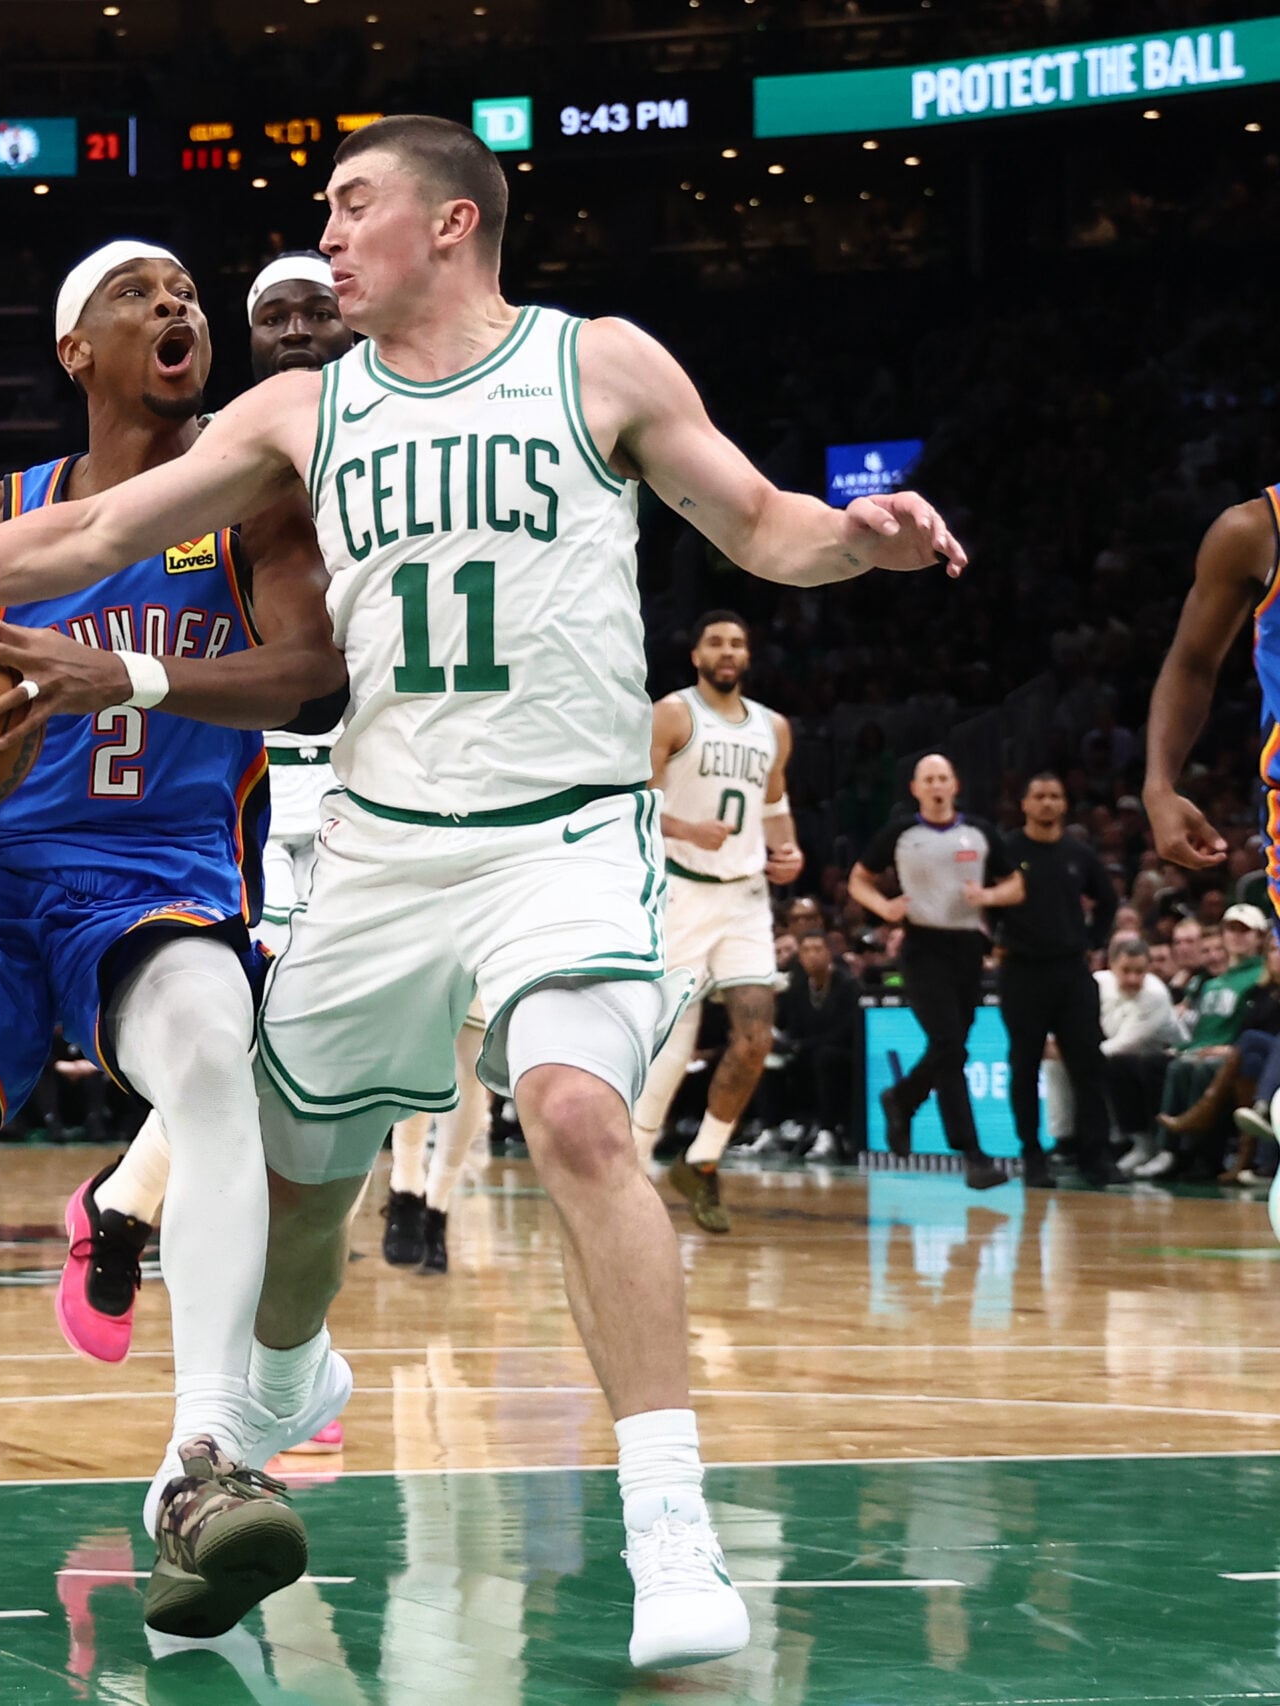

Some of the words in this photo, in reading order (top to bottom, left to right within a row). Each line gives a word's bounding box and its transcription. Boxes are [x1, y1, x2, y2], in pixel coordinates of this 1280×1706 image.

[912, 51, 1079, 119] PROTECT
[1083, 43, 1138, 97] THE
[1143, 30, 1245, 91] BALL
[477, 106, 527, 142] TD
[560, 105, 630, 135] 9:43
[636, 98, 689, 130] PM
[86, 133, 119, 160] 21
[487, 383, 553, 400] Amica
[336, 433, 560, 562] CELTICS
[49, 603, 233, 660] UNDER
[391, 561, 510, 692] 11
[88, 704, 147, 799] 2
[698, 741, 768, 788] CELTICS
[717, 788, 745, 835] 0
